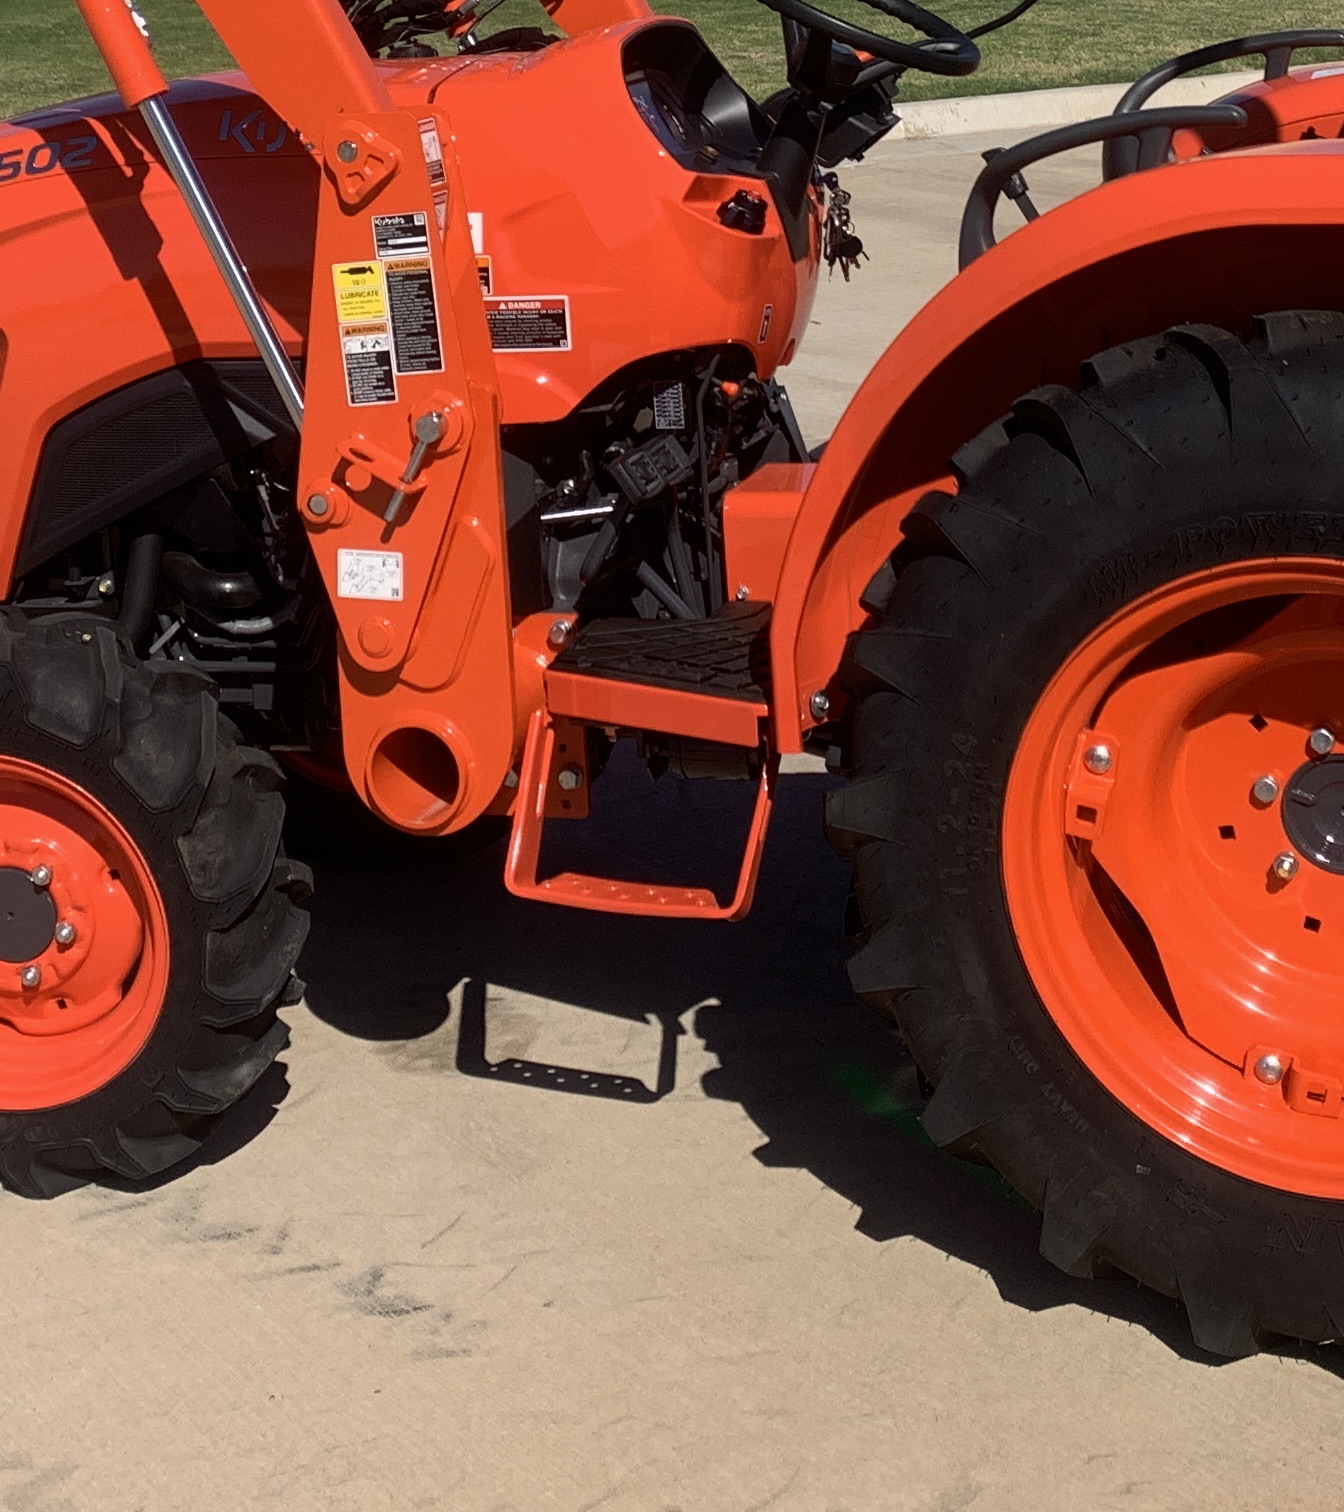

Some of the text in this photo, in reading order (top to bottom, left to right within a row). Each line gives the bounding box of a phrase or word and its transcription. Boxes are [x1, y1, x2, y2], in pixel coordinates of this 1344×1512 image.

[393, 260, 428, 269] WARNING
[340, 290, 379, 300] LUBRICATE
[508, 301, 542, 309] DANGER
[351, 325, 385, 334] WARNING
